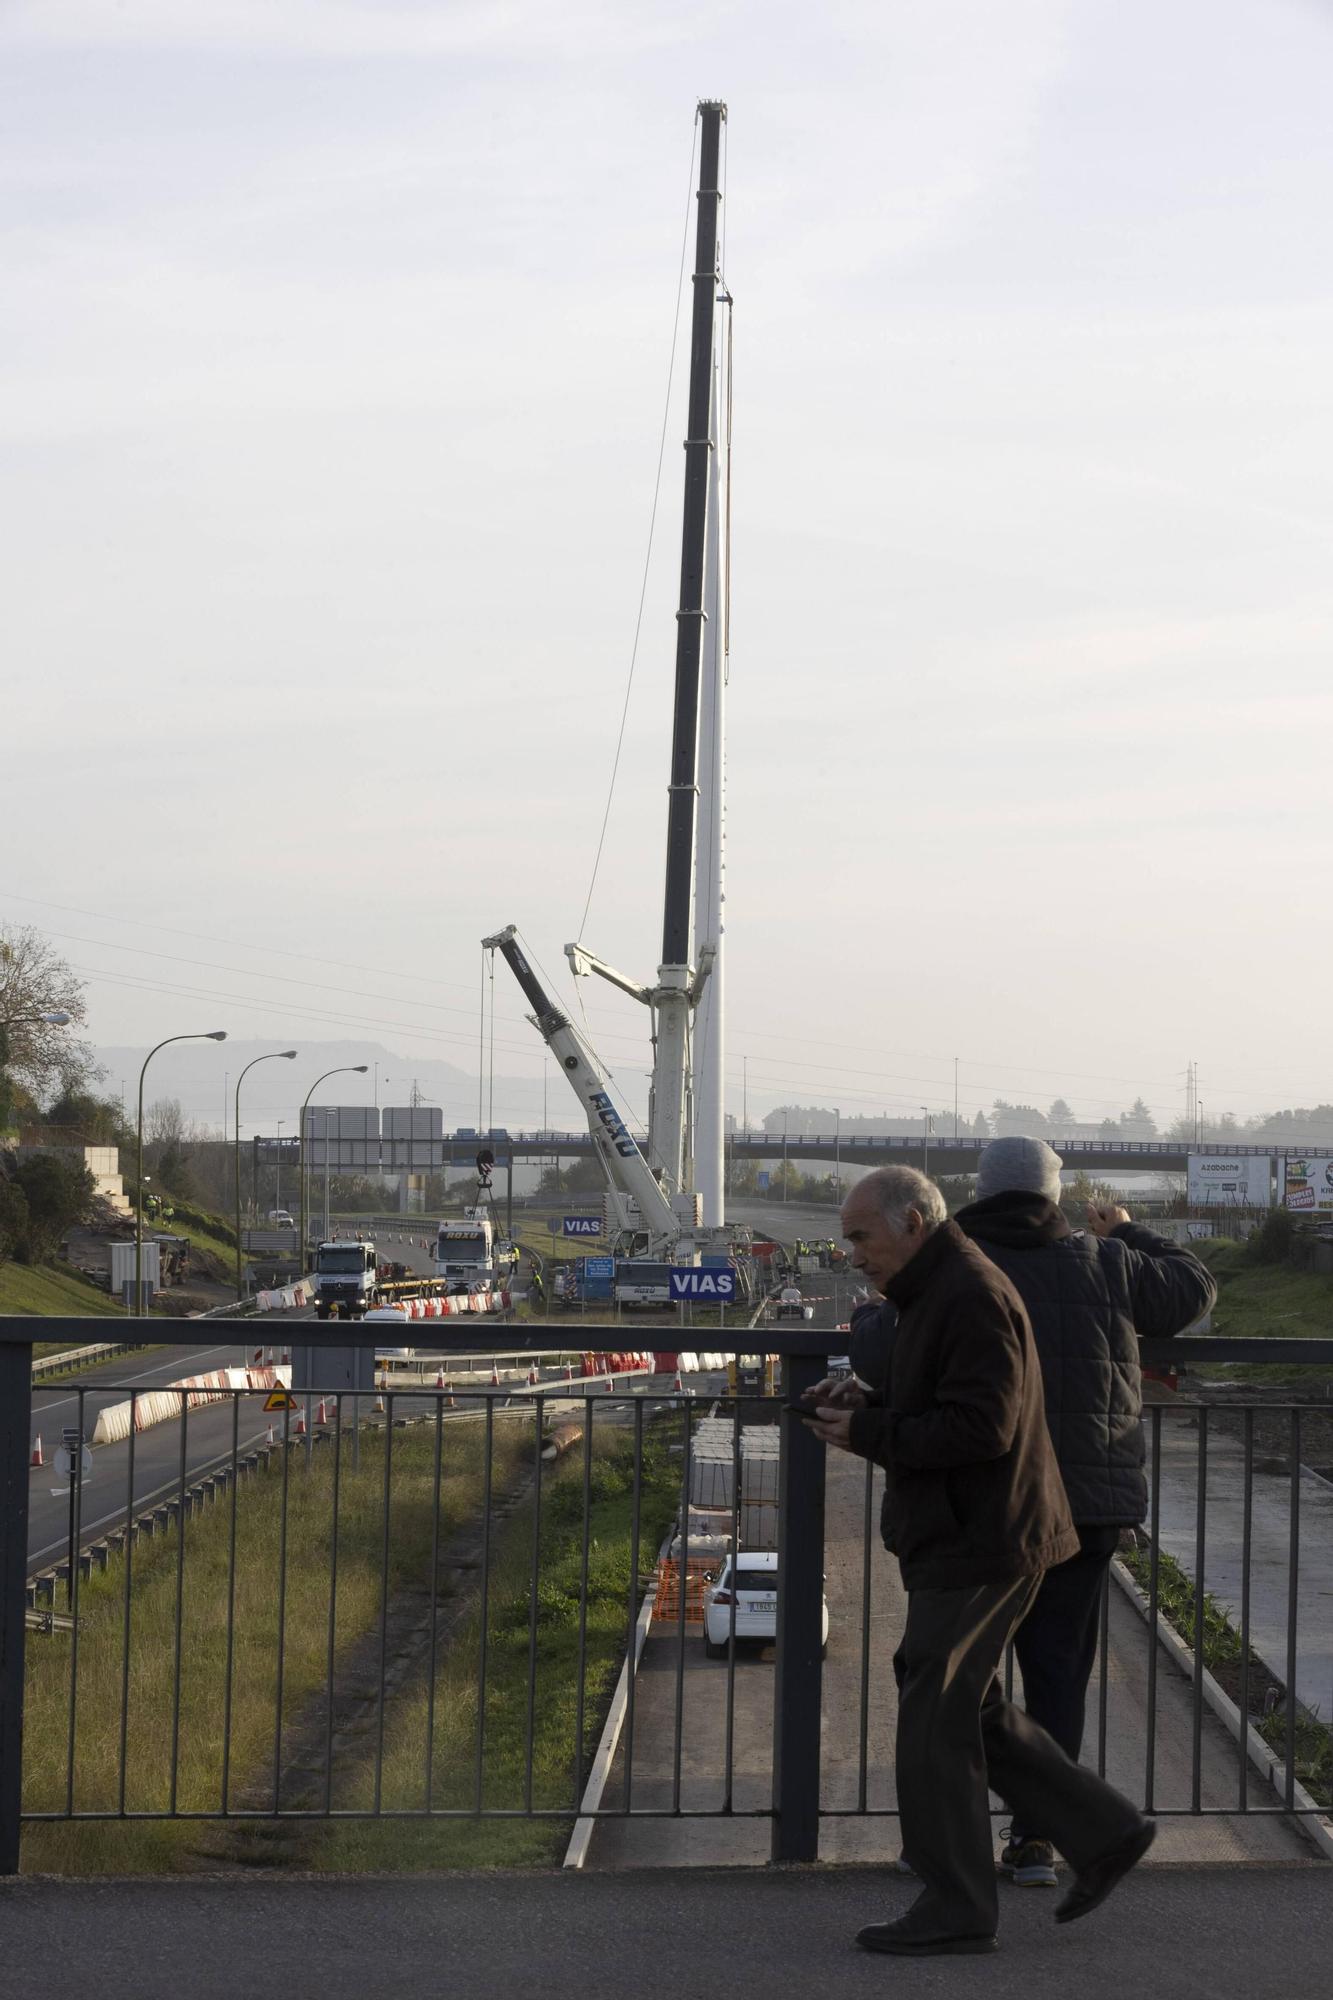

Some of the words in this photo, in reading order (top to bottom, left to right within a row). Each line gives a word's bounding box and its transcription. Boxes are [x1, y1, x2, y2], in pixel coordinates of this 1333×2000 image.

[588, 1092, 640, 1157] ROXU
[565, 1220, 600, 1232] VIAS
[672, 1274, 733, 1293] VIAS
